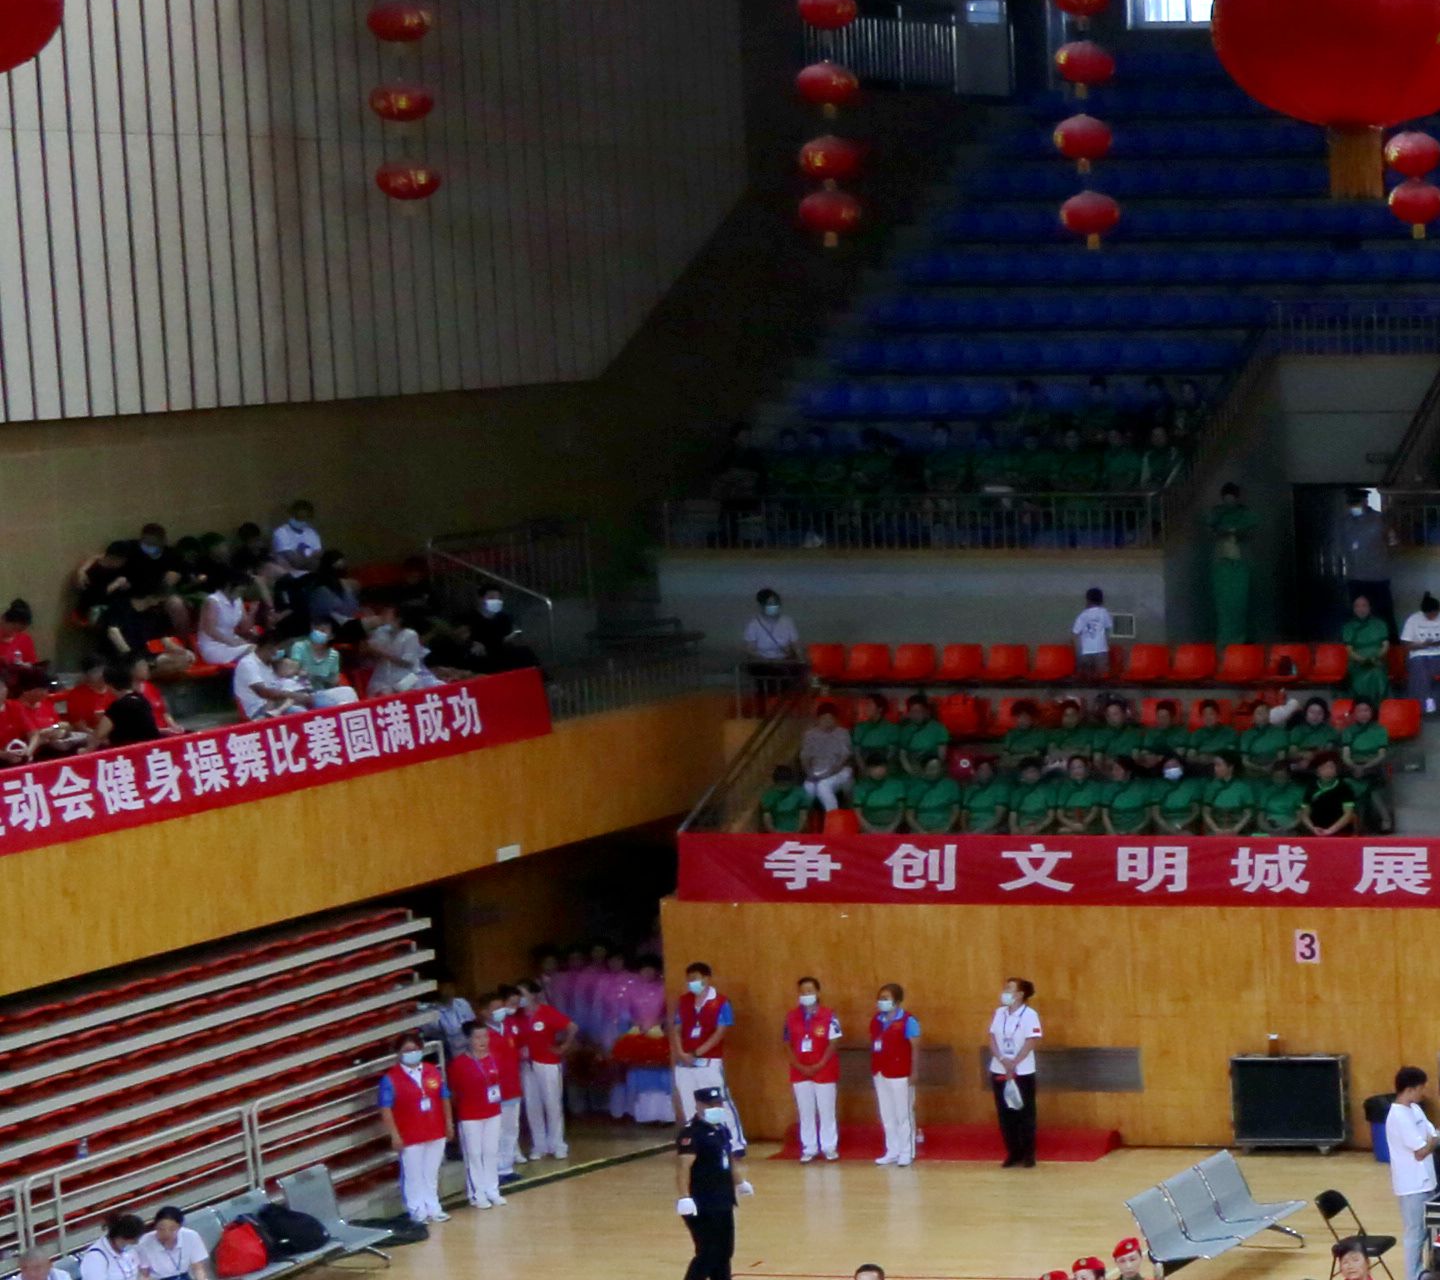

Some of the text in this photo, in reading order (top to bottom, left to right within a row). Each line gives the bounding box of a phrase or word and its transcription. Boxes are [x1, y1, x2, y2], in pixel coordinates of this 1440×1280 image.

[0, 687, 482, 837] 动会健身操舞比赛圆满成功
[1299, 933, 1316, 959] 3
